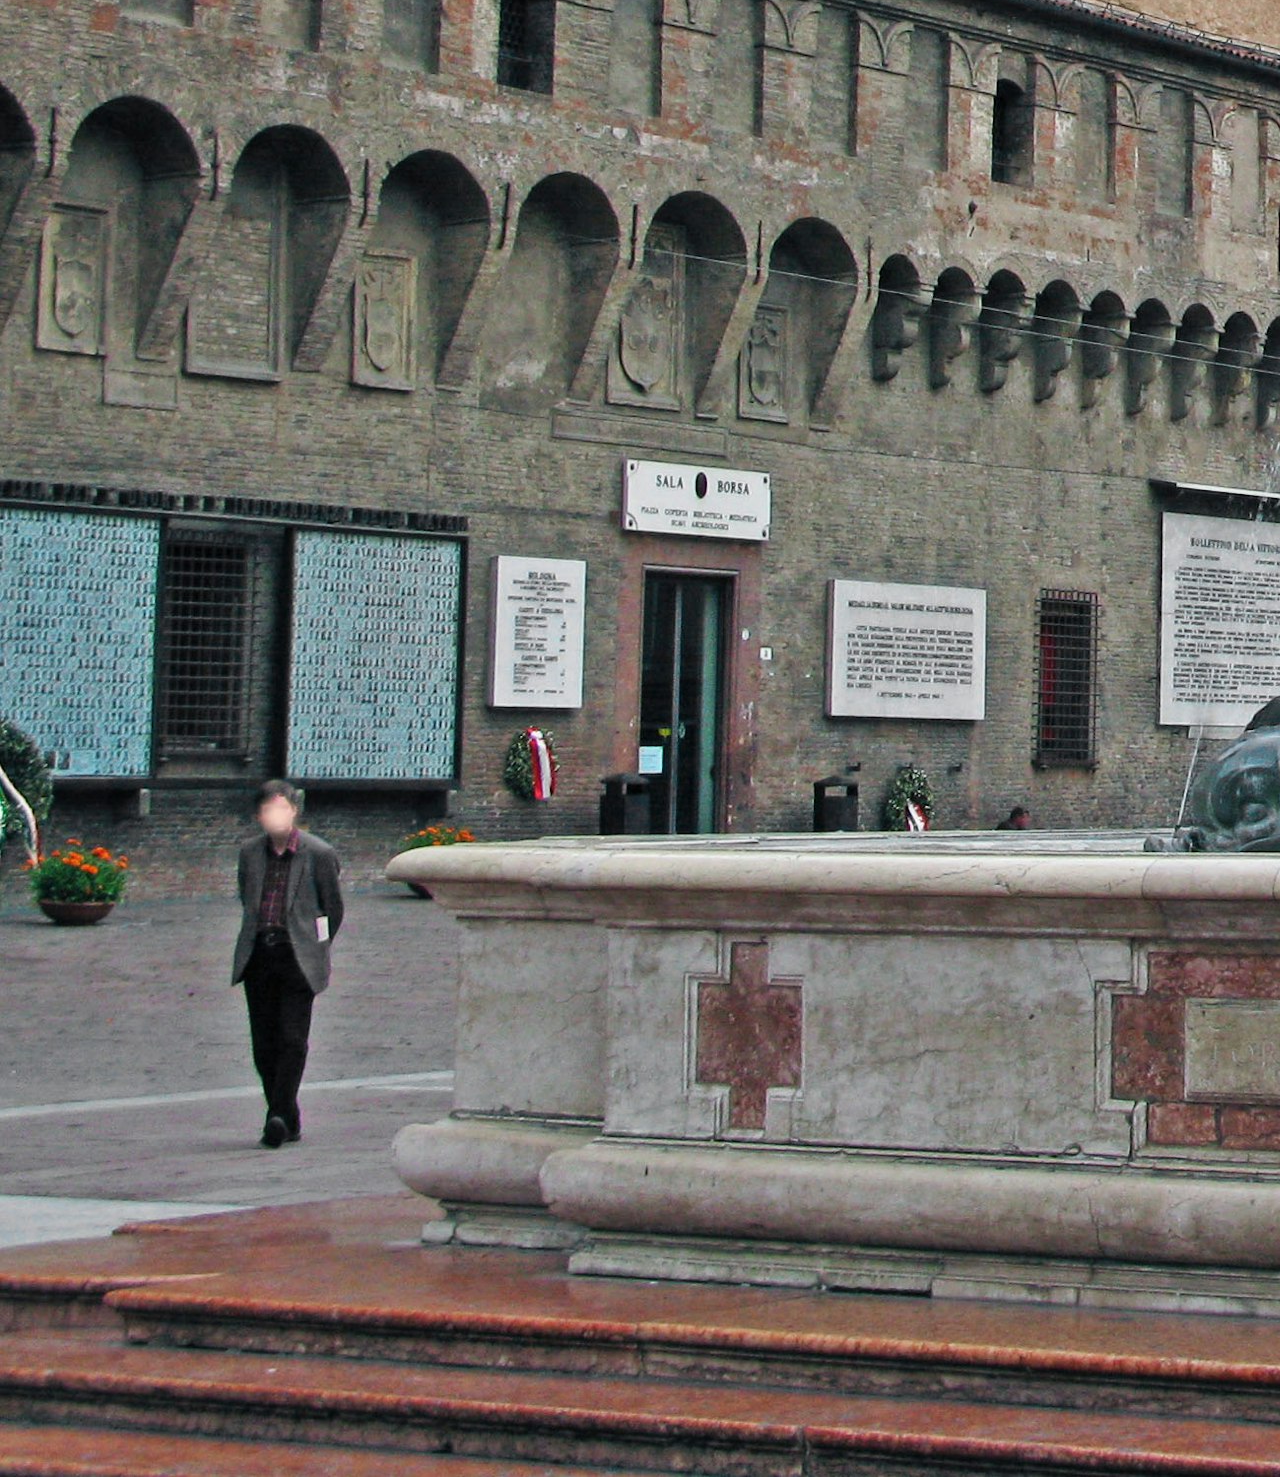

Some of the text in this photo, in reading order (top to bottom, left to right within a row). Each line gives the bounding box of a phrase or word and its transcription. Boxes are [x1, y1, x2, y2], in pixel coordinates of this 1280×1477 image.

[656, 474, 750, 495] SALA BORSA
[1190, 537, 1232, 551] BOLLETTINO
